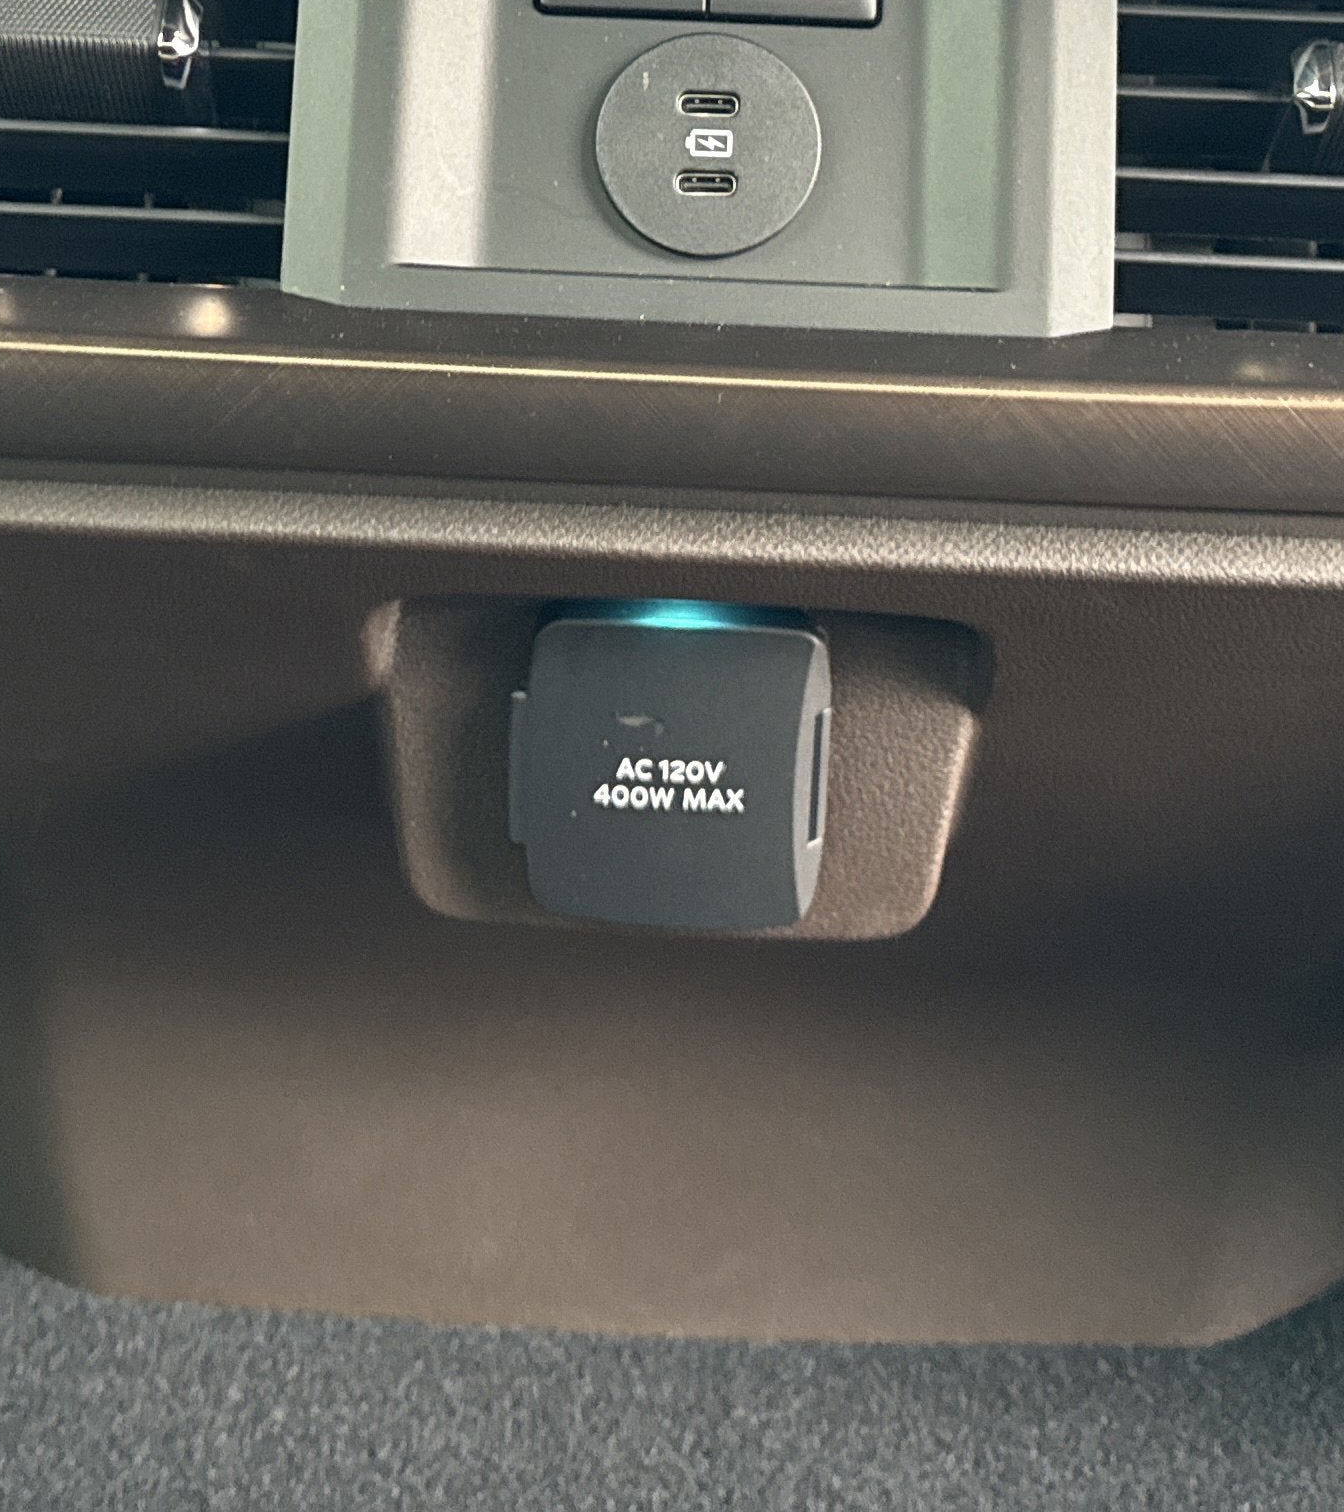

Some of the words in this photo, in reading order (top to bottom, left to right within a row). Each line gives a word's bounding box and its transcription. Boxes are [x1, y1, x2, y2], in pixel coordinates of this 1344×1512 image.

[615, 756, 653, 783] AC
[658, 759, 727, 785] 120V
[592, 783, 675, 811] 400W
[682, 787, 745, 814] MAX
